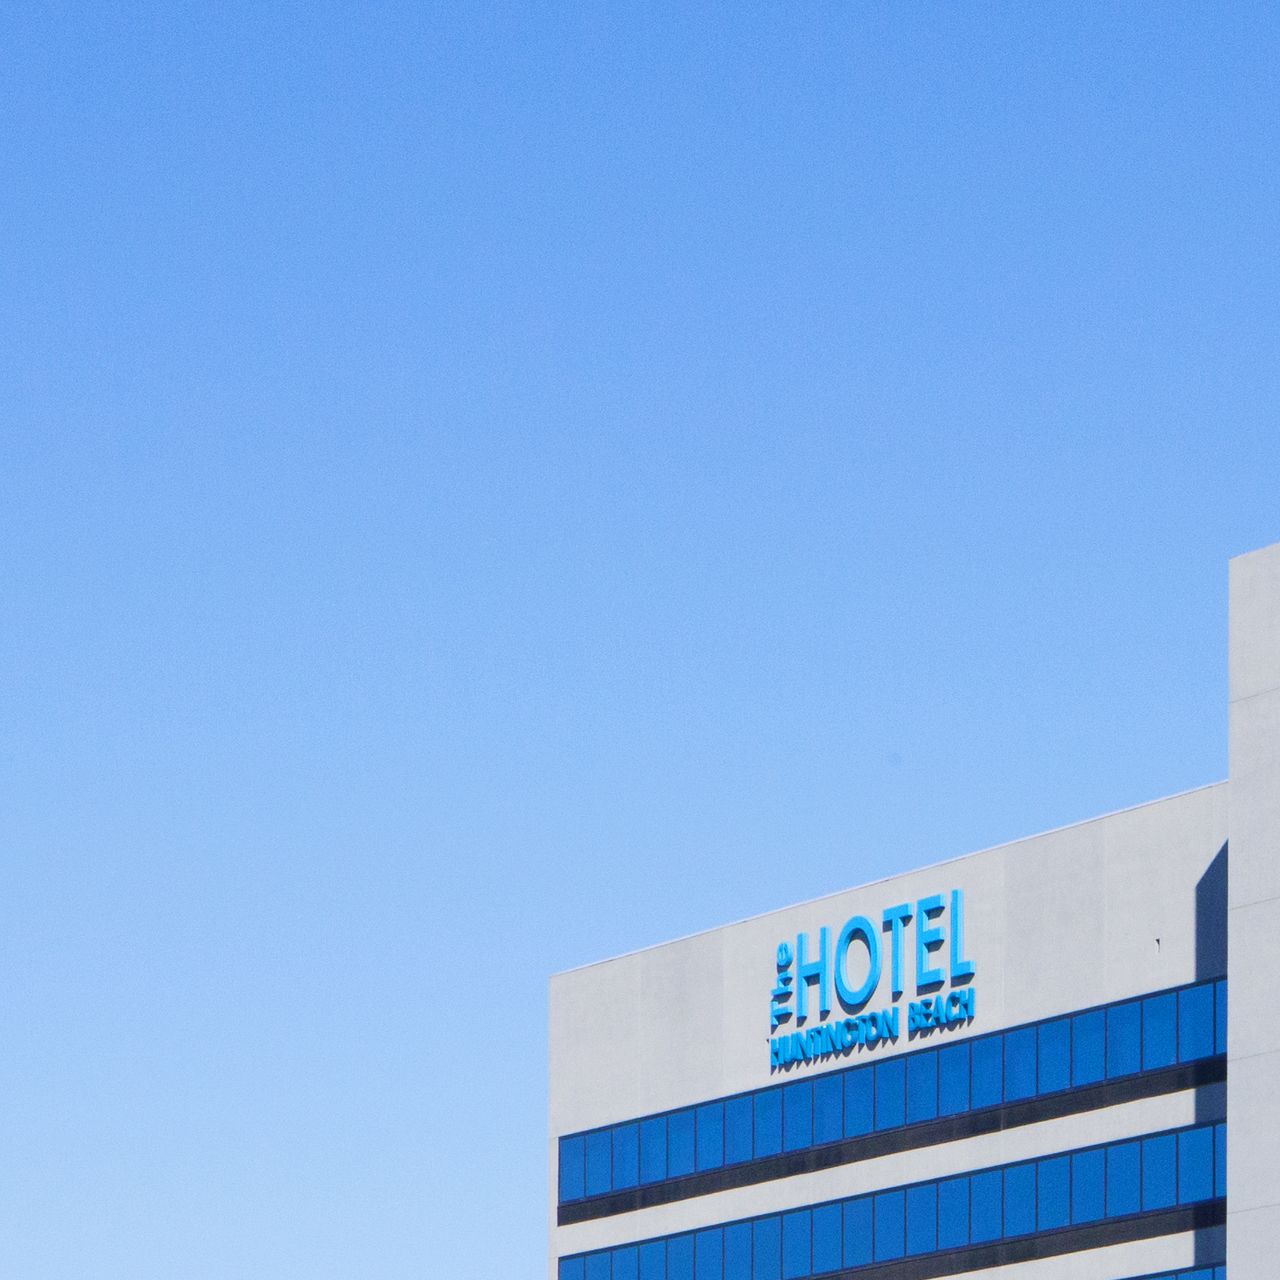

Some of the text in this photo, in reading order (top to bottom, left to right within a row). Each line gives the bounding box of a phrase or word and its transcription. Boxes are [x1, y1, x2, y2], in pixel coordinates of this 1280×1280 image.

[769, 940, 794, 1027] The
[796, 887, 977, 1022] HOTEL
[769, 988, 976, 1070] HUNTINGTON BEACH
